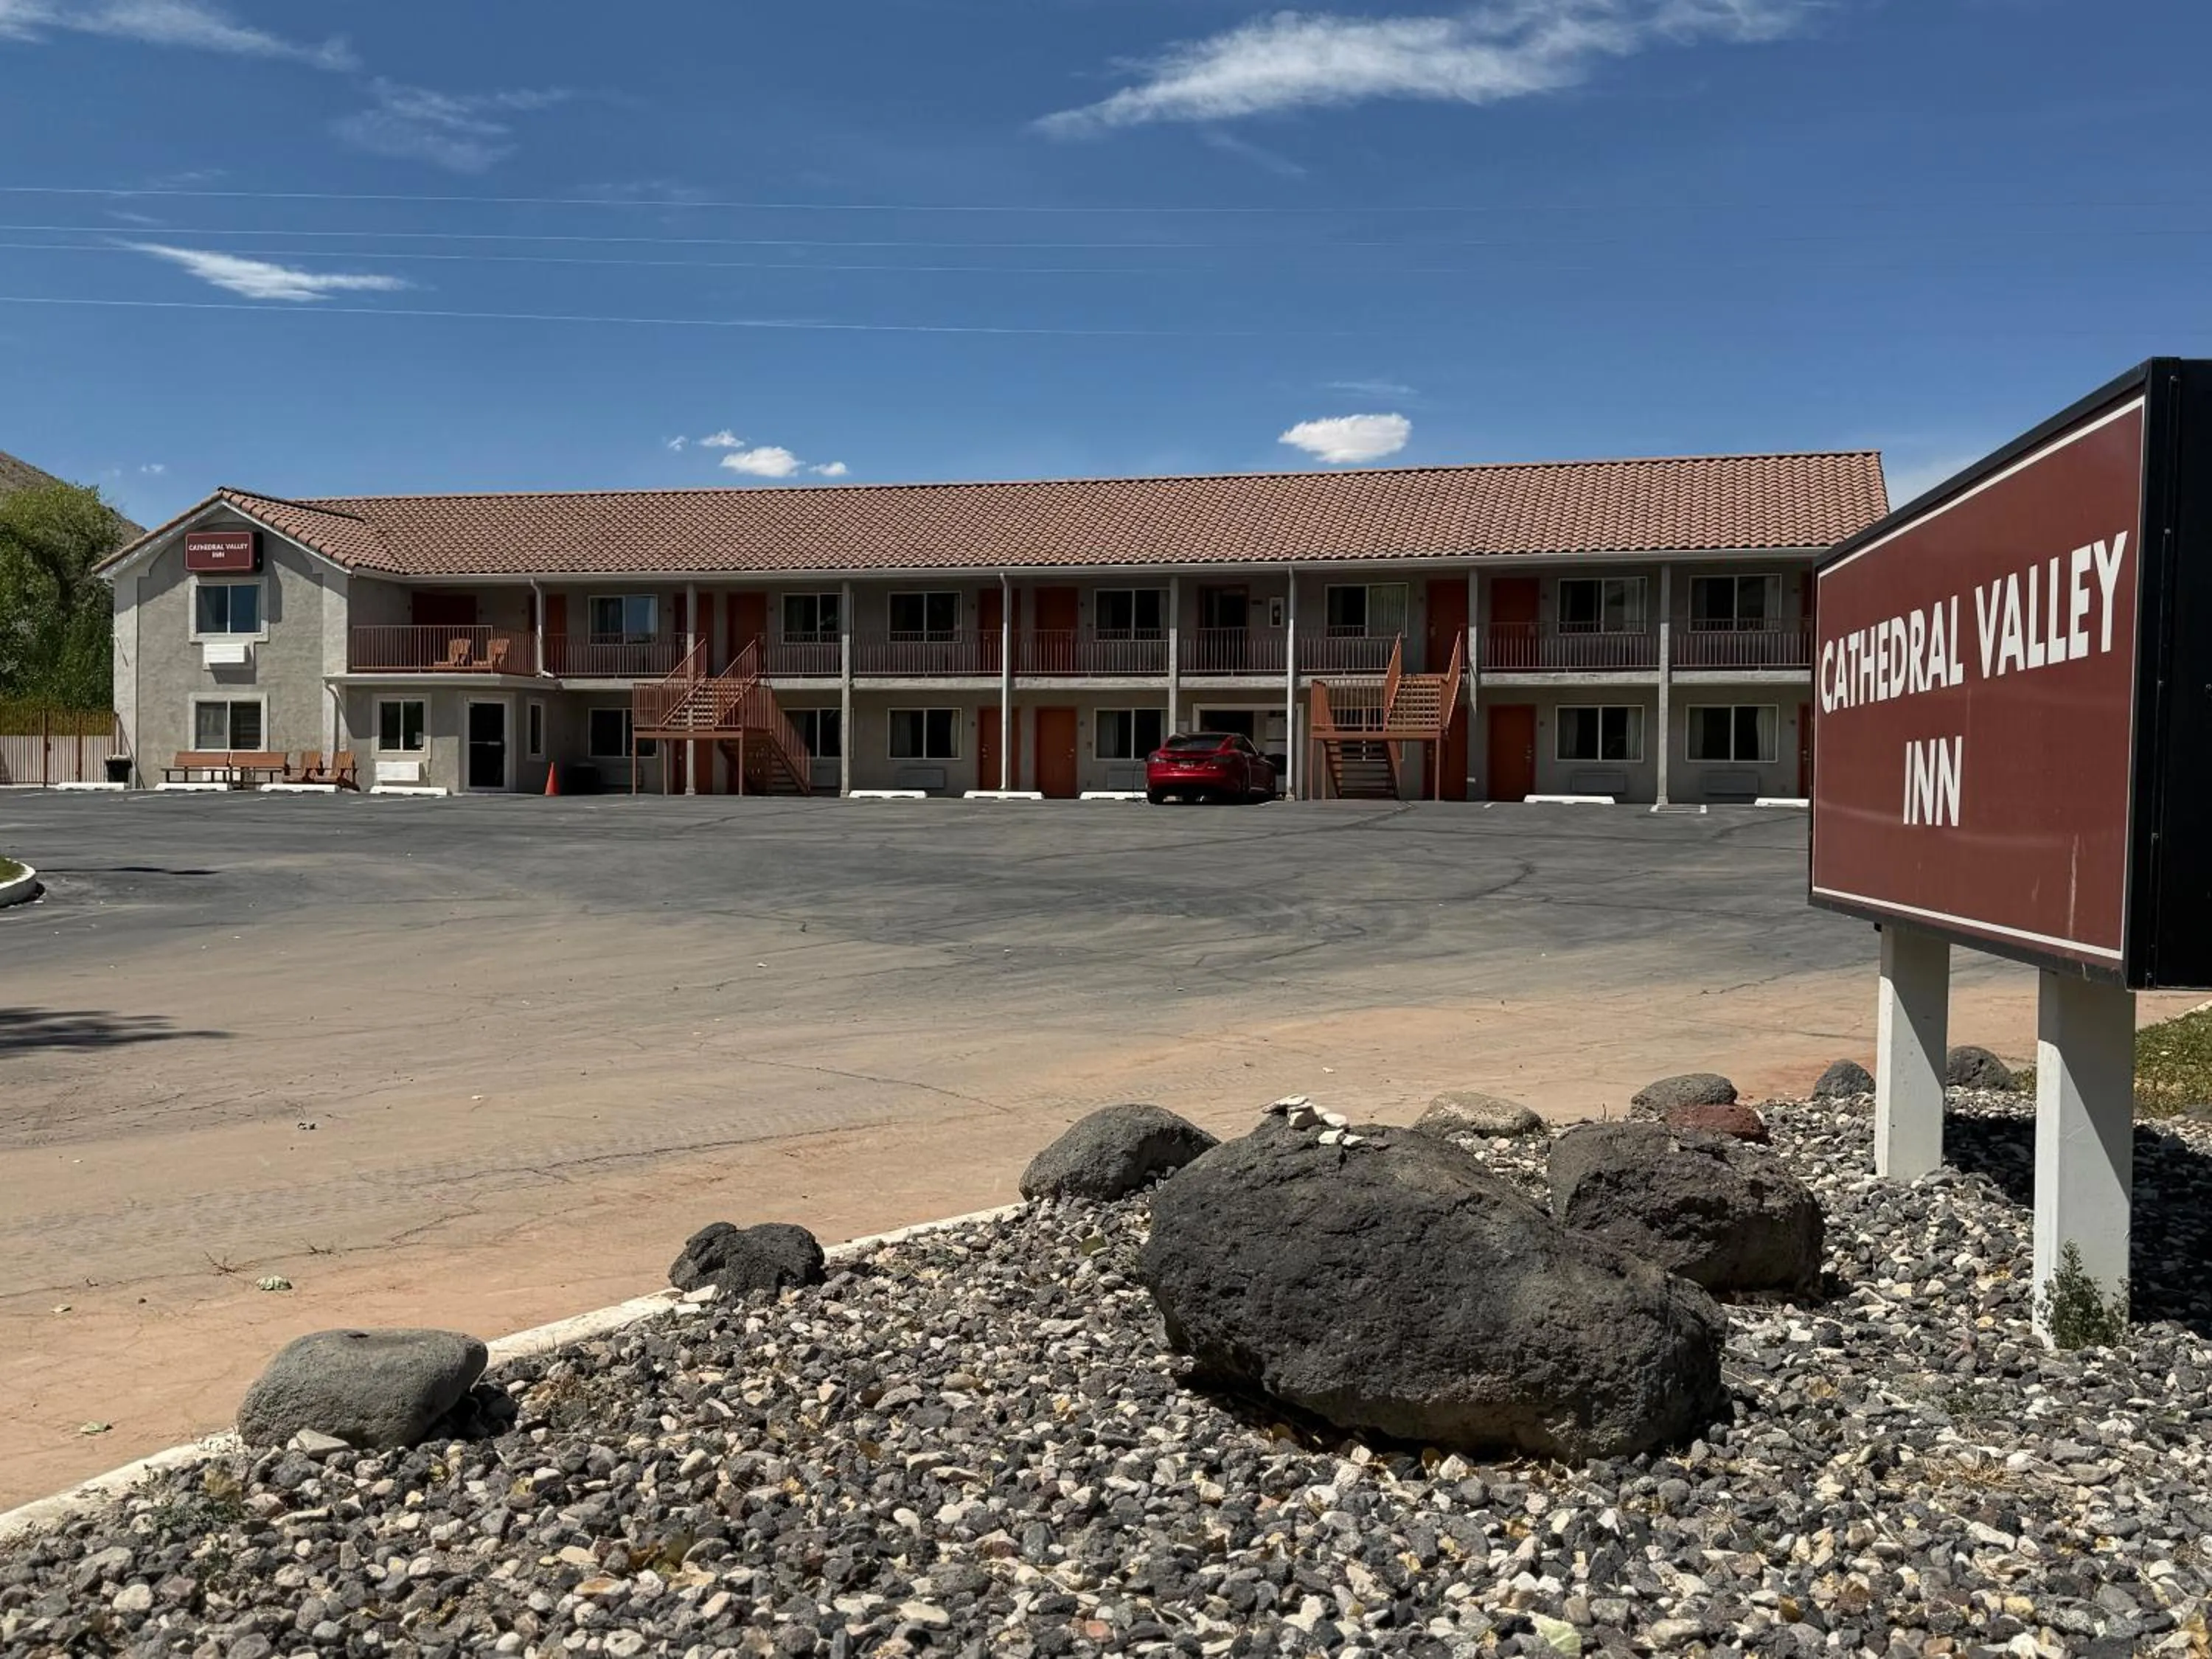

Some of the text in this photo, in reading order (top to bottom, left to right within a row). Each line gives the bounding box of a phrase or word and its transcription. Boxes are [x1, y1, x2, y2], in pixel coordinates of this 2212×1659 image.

[1820, 530, 2128, 714] CATHEDRAL VALLEY
[1903, 735, 1962, 827] INN
